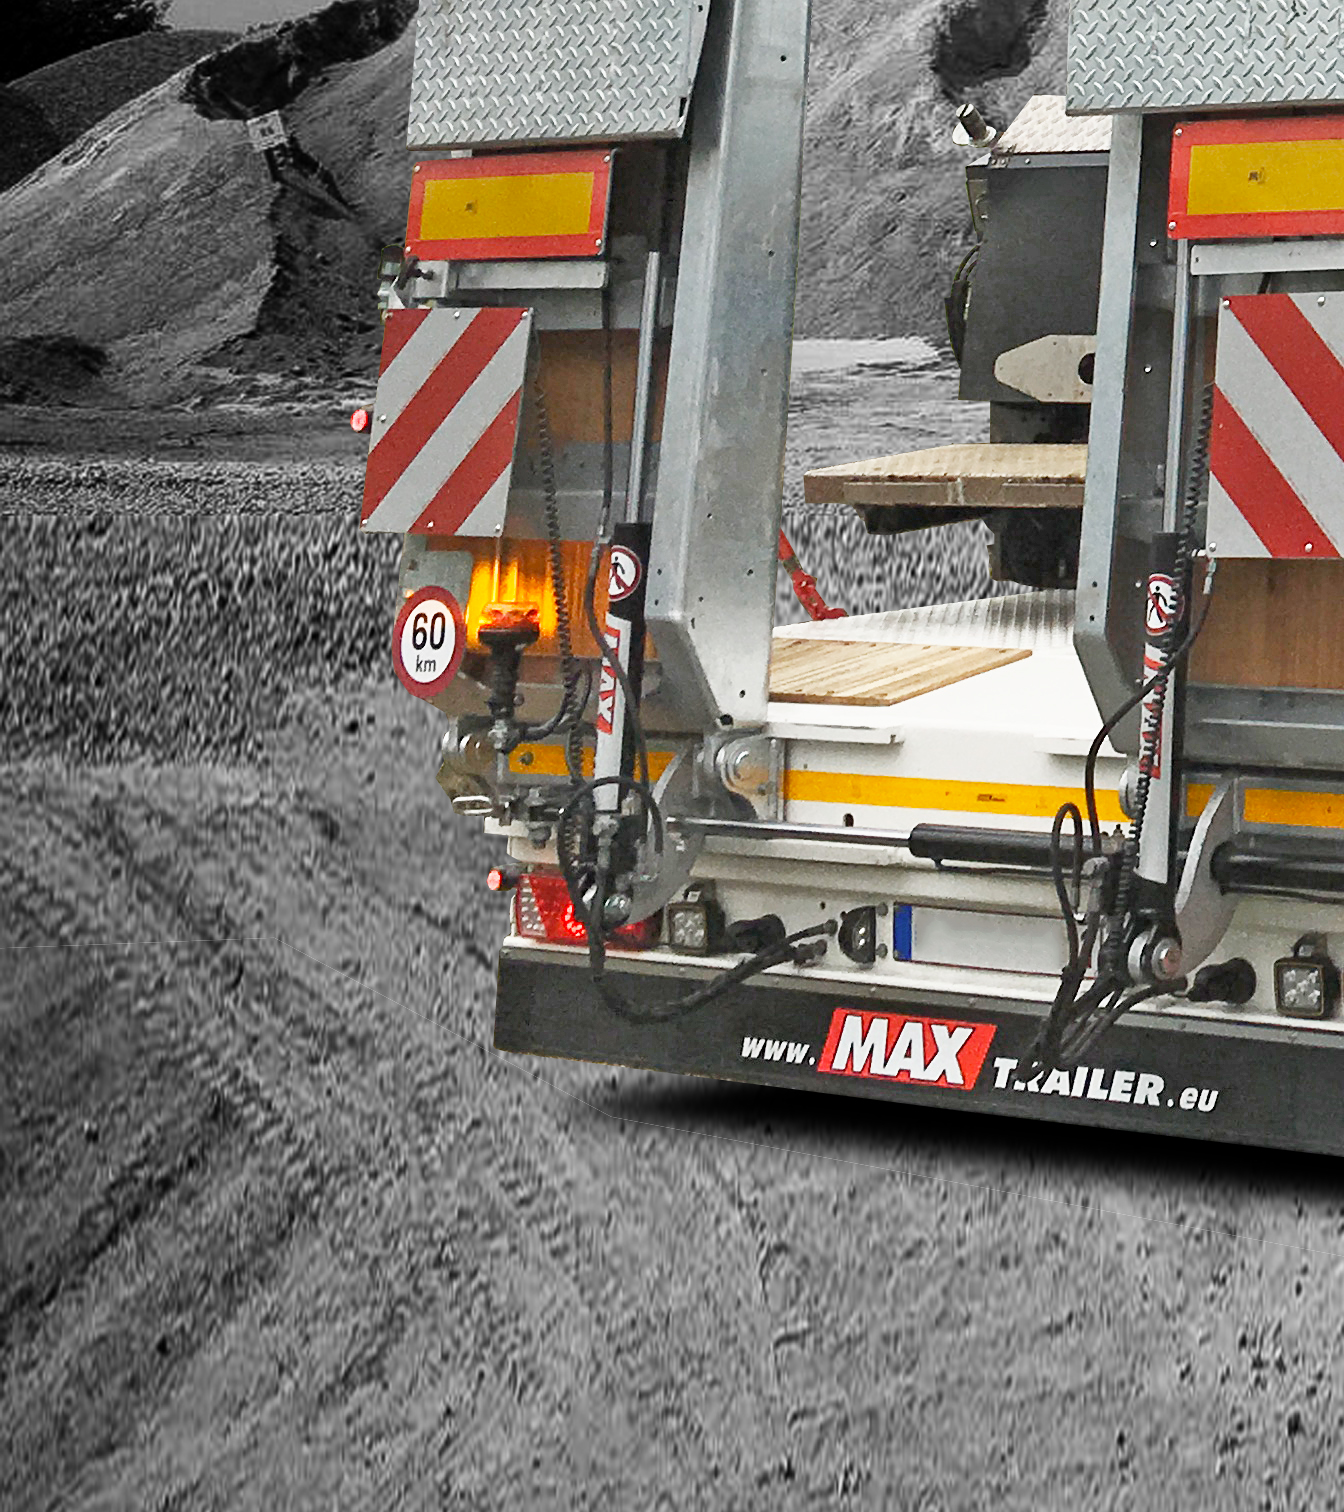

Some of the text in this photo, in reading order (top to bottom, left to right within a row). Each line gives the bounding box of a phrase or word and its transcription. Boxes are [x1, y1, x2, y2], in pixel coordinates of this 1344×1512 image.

[412, 612, 446, 650] 60
[415, 654, 437, 673] km
[831, 1014, 974, 1085] MAX
